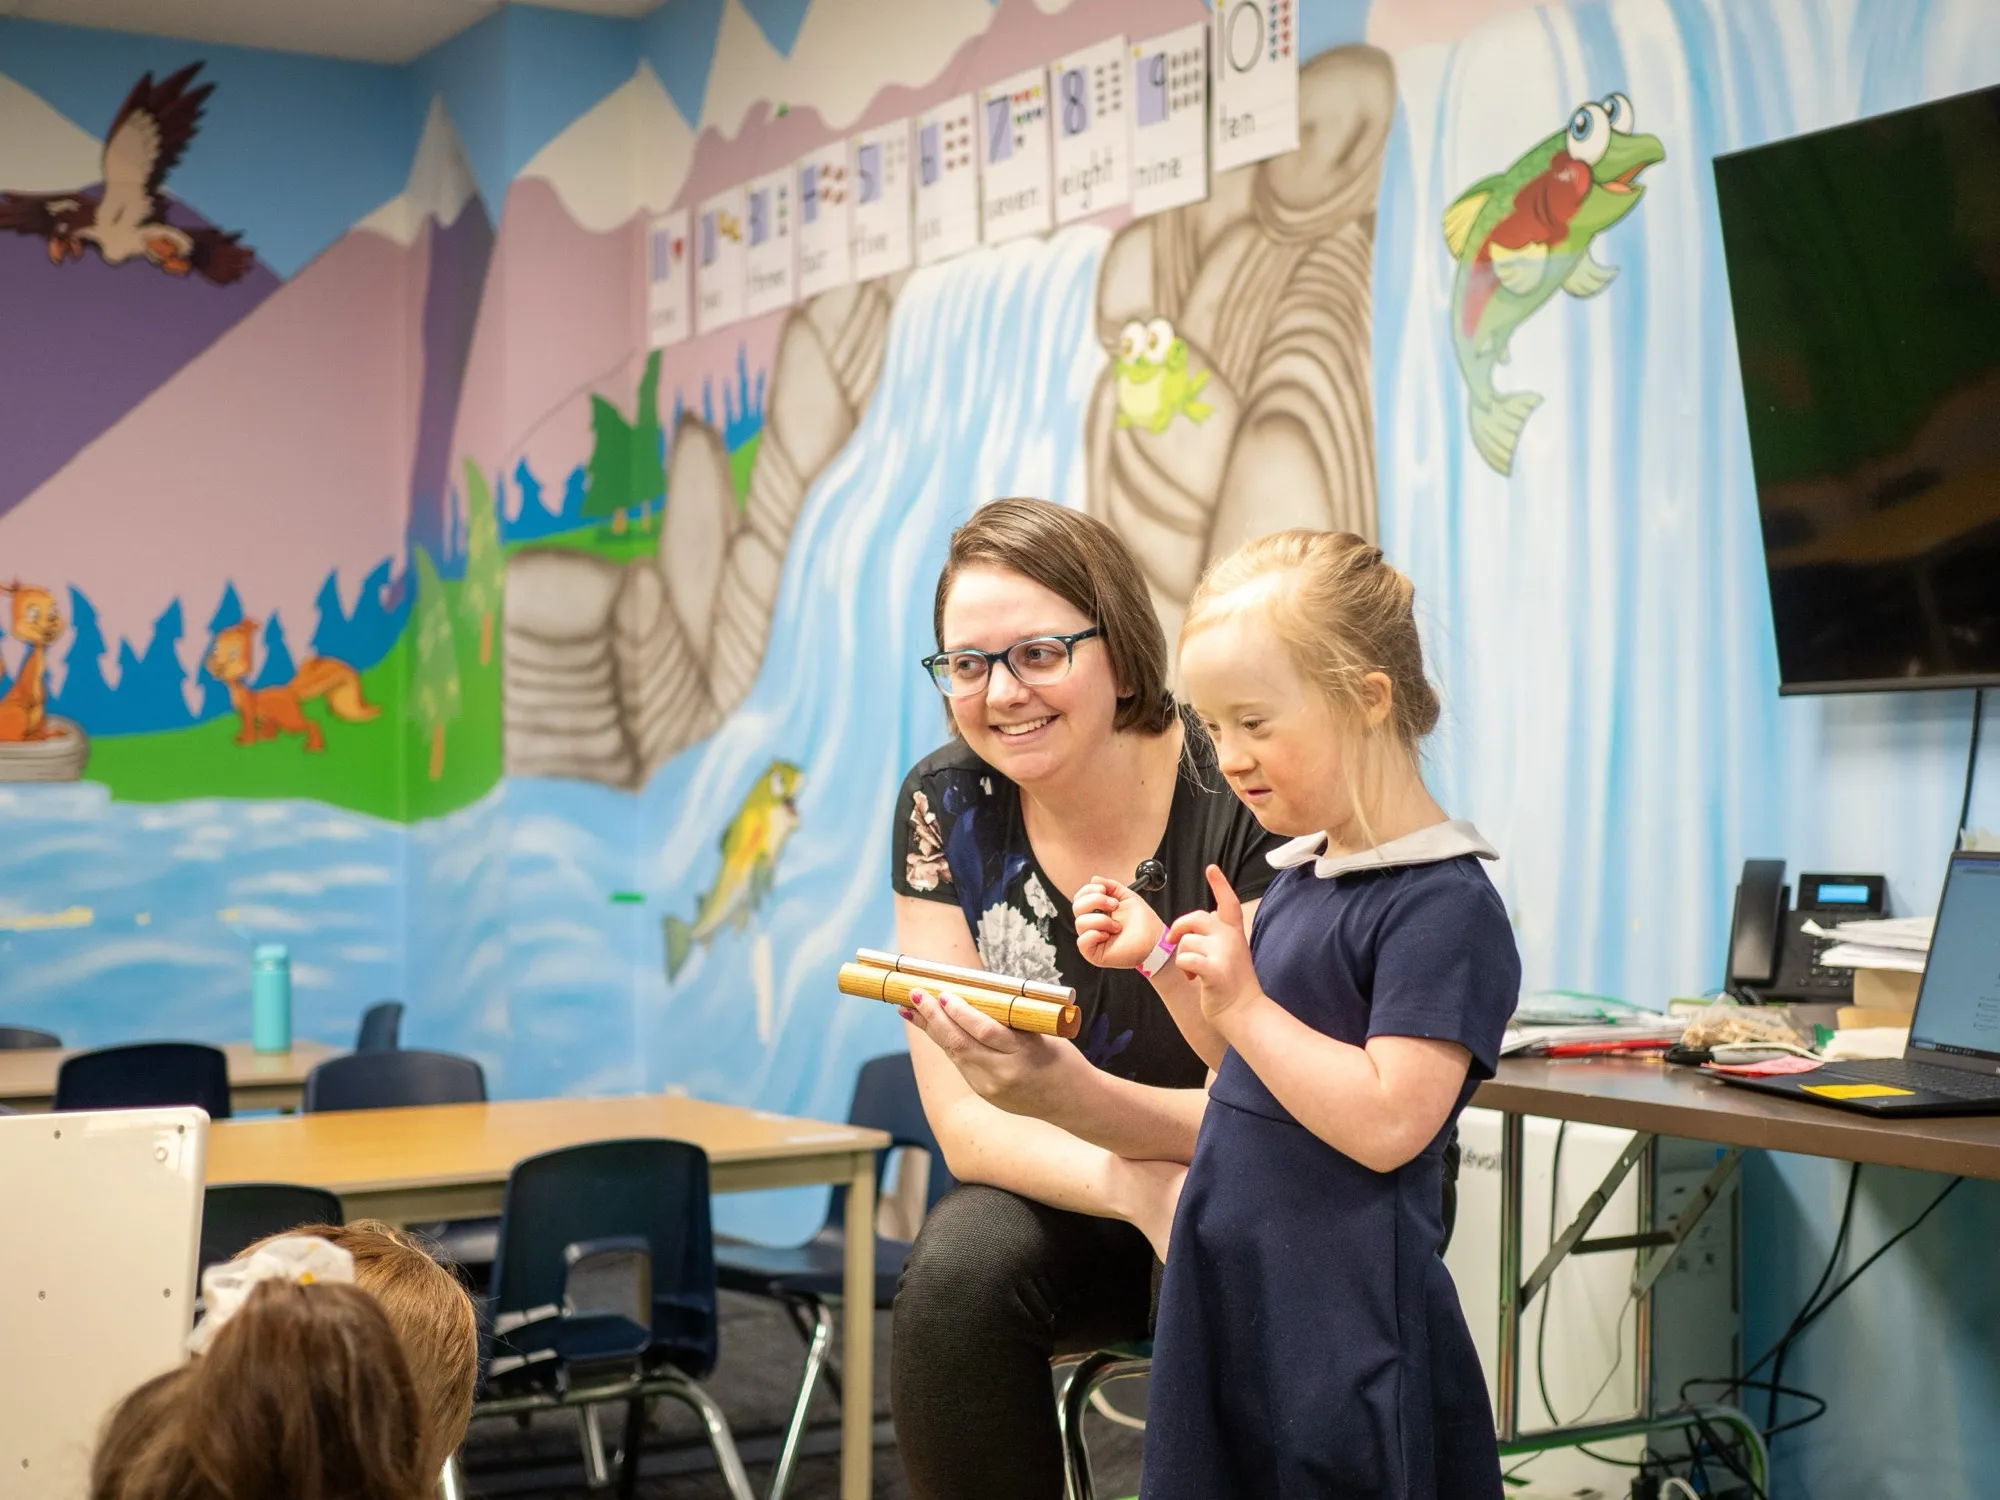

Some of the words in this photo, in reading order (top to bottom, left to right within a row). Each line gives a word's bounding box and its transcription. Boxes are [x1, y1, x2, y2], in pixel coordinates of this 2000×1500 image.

[1217, 1, 1264, 82] 10
[1062, 69, 1087, 135] 8
[1150, 53, 1170, 120] 9
[986, 96, 1010, 164] 7
[1219, 102, 1256, 142] ten
[1059, 147, 1113, 210] eight
[1135, 158, 1182, 189] nine
